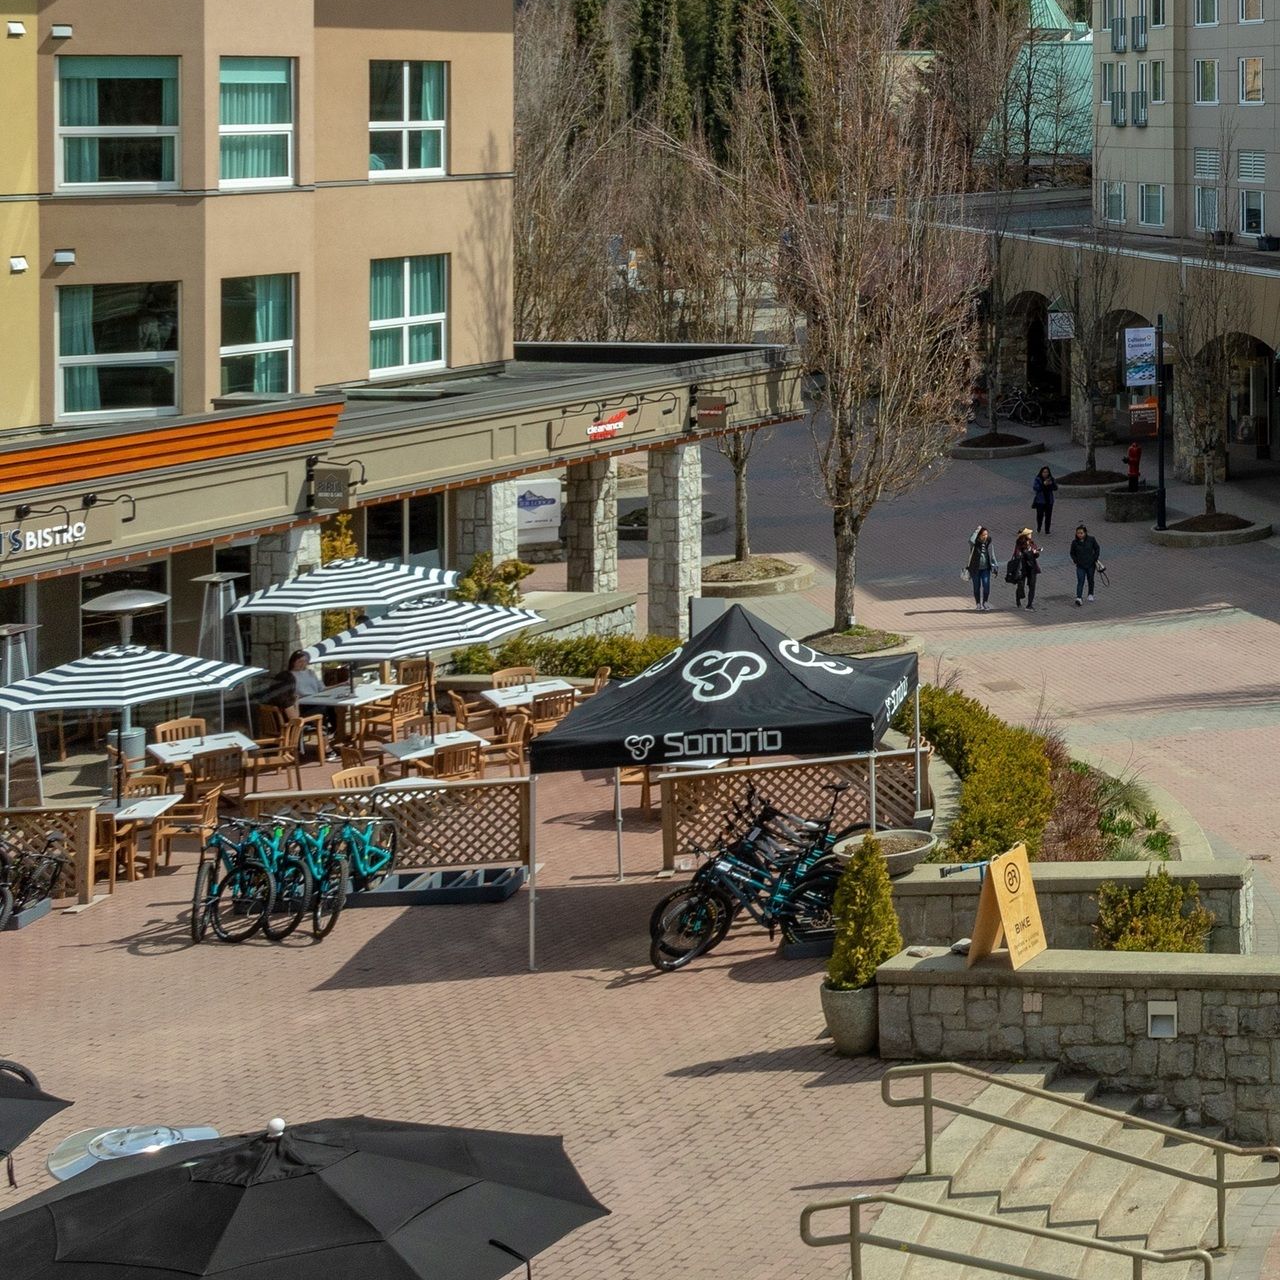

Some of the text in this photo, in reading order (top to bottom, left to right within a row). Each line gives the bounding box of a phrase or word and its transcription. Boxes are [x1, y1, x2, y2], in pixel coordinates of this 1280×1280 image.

[586, 420, 625, 435] clearance
[25, 522, 86, 551] BISTRO
[663, 727, 782, 758] Sombrio
[1014, 916, 1032, 934] BIKE
